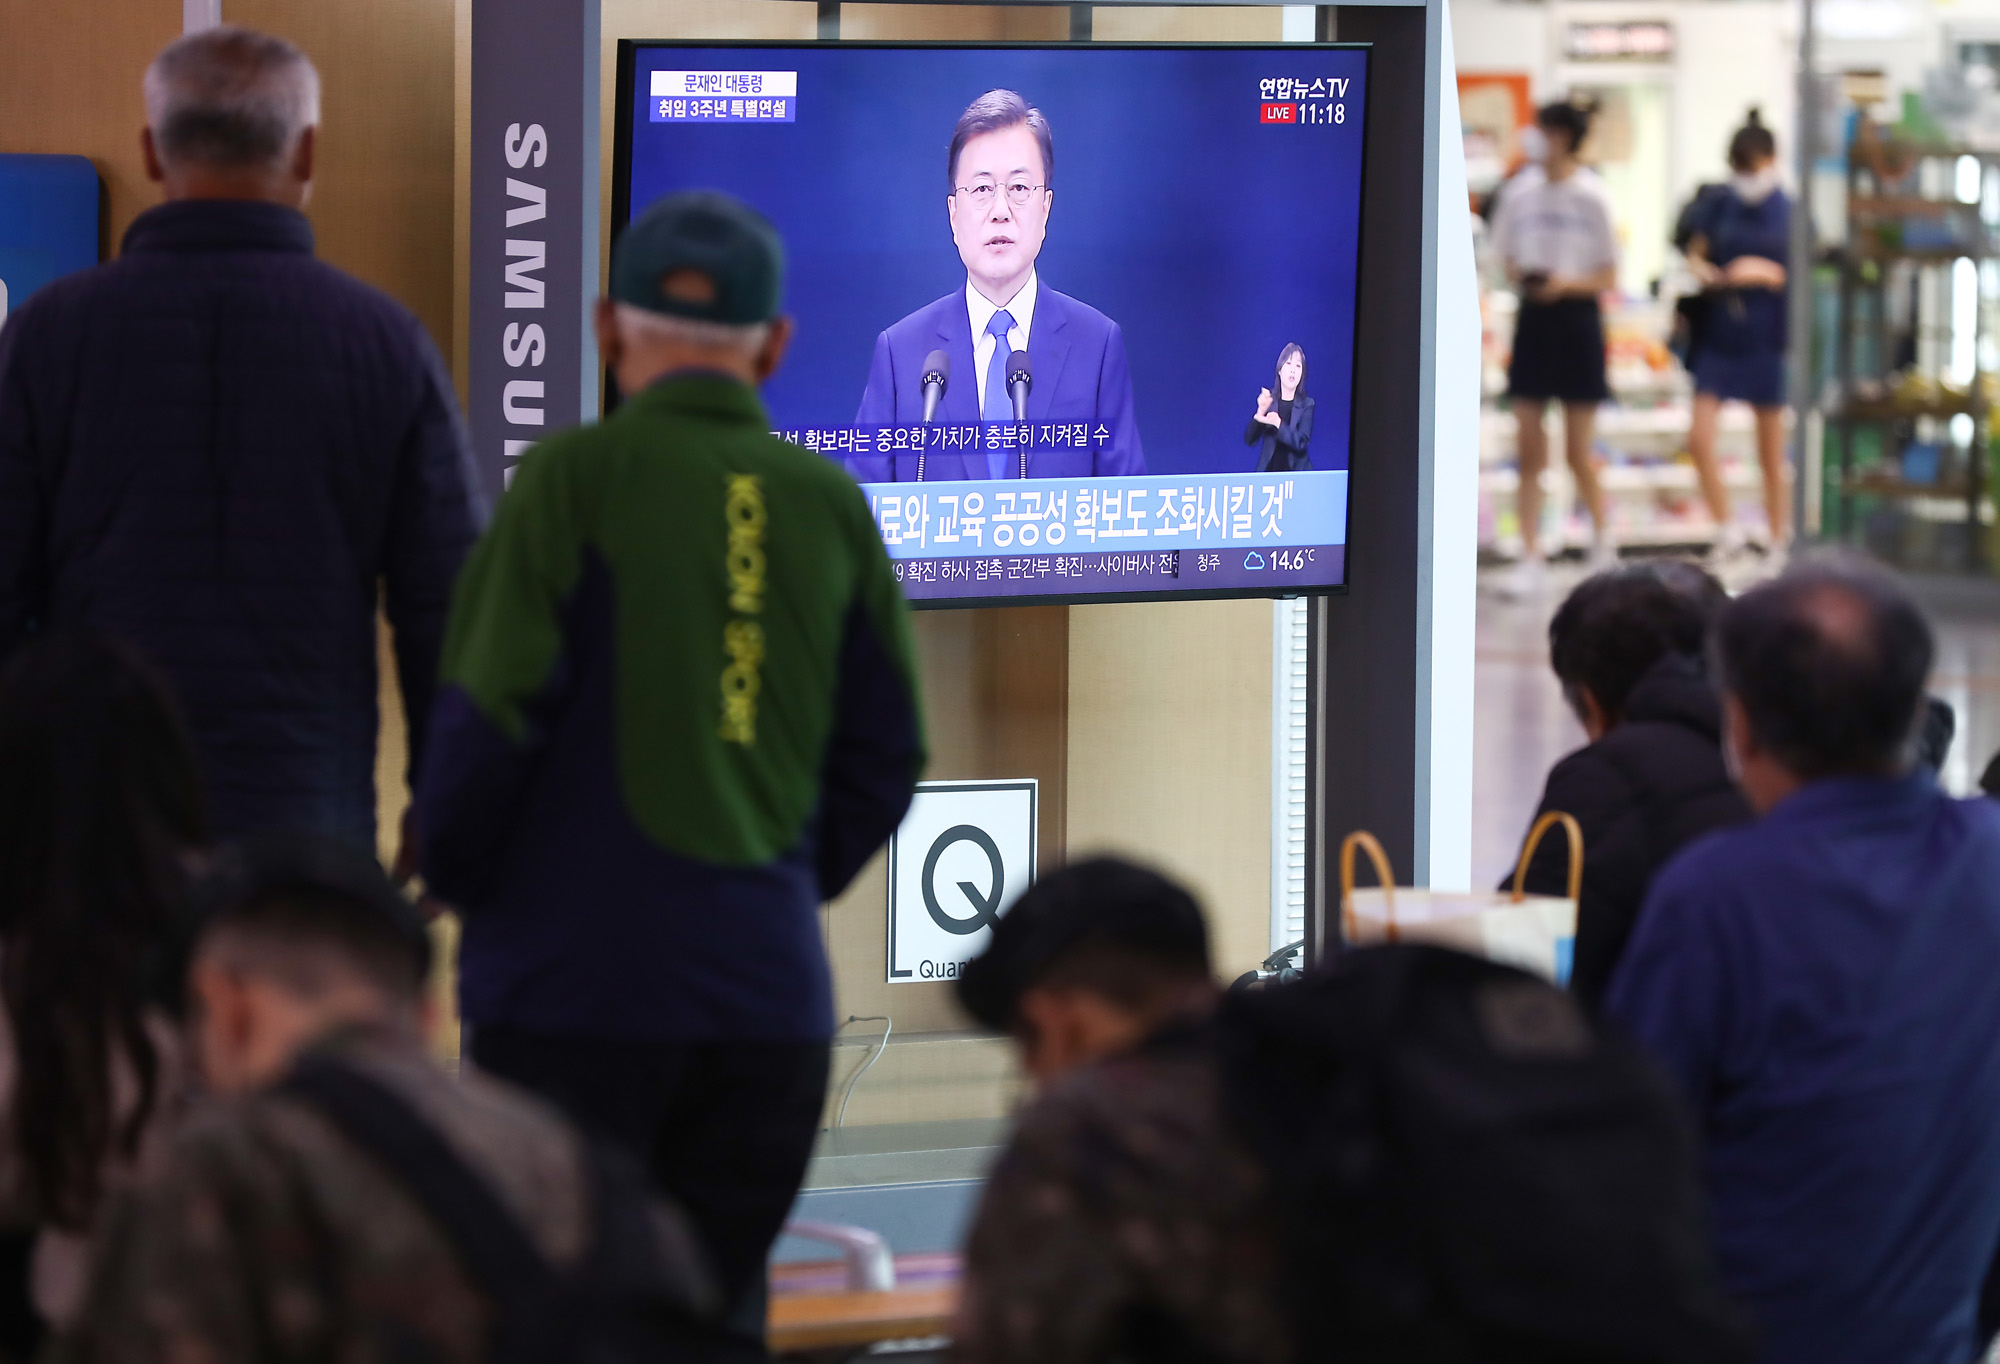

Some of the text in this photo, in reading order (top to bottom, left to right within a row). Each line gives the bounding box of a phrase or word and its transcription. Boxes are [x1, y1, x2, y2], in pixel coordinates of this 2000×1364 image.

[684, 74, 763, 93] 문재인 대통령
[1259, 78, 1350, 100] 연합뉴스TV
[658, 99, 786, 118] 취임 3주년 특별연설
[1267, 103, 1345, 124] LIVE 11:18
[804, 429, 871, 453] 확보라는
[876, 427, 927, 452] 중요한
[931, 425, 981, 450] 가치가
[985, 424, 1034, 450] 충분히
[1039, 423, 1088, 448] 지켜질
[1092, 422, 1110, 446] 수
[934, 491, 986, 548] 교육
[991, 489, 1068, 547] 공공성
[1073, 488, 1149, 544] 확보도
[1154, 484, 1254, 540] 조화시킬
[908, 561, 937, 582] 확진
[941, 560, 970, 581] 하사
[974, 558, 1003, 580] 접촉
[1007, 557, 1050, 580] 군간부
[1197, 553, 1221, 572] 청주
[718, 473, 767, 743] KOLON SPORT
[921, 824, 1005, 936] Q
